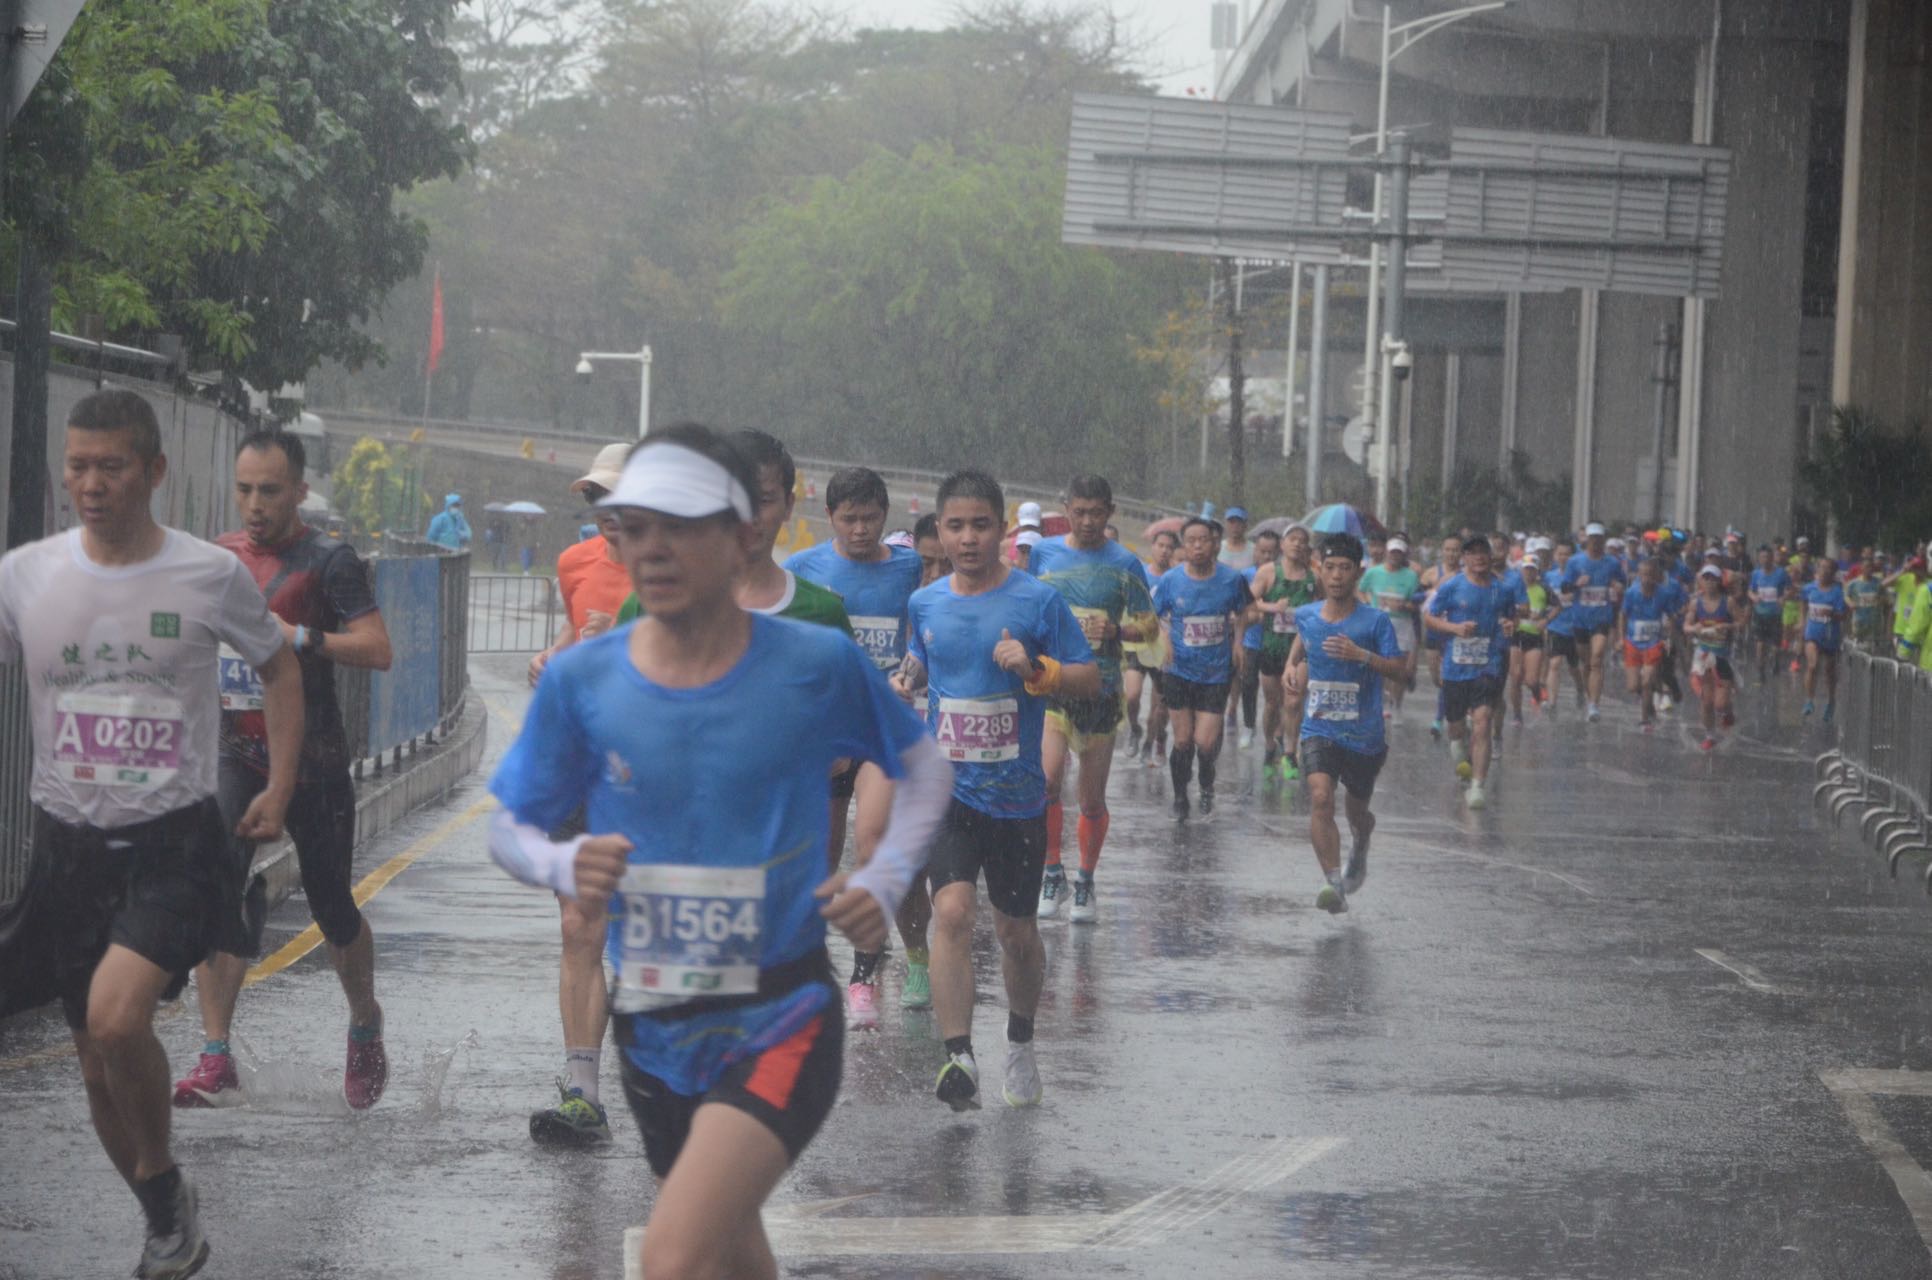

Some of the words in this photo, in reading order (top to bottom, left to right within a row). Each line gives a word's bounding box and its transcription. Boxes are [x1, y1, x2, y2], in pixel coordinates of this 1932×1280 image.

[854, 630, 897, 648] 2487
[1184, 622, 1195, 638] A
[1310, 690, 1319, 706] B
[1321, 691, 1357, 705] 2958
[55, 712, 84, 753] A
[95, 717, 173, 750] 0202
[937, 712, 957, 741] A
[962, 714, 1014, 737] 2289
[624, 895, 652, 949] B
[658, 898, 760, 942] 1564
